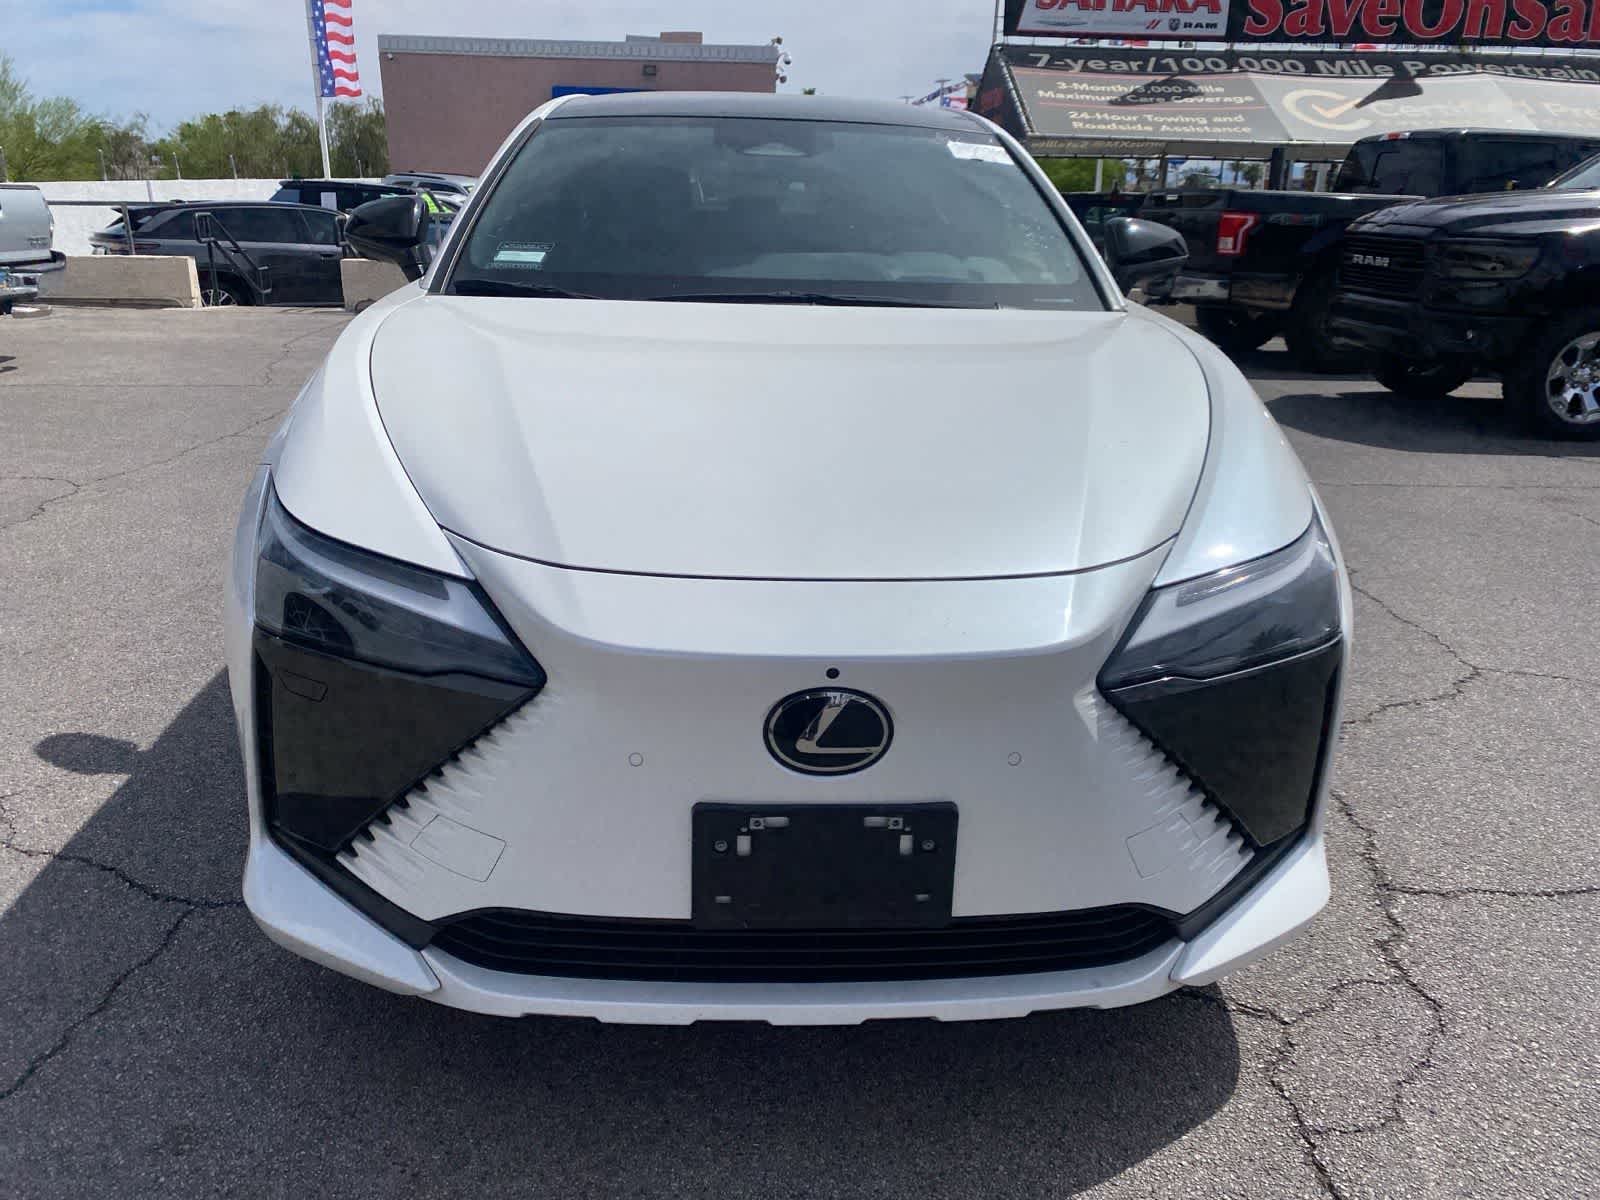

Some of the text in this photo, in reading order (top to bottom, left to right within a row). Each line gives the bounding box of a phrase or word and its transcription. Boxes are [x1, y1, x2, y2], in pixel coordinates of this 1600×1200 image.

[1183, 21, 1218, 30] RAM
[1315, 59, 1395, 76] Mile
[1402, 61, 1600, 81] Powertrain
[1037, 90, 1120, 102] Maximum
[1171, 95, 1255, 104] Coverage
[1068, 111, 1246, 125] 24-Hour Towing and
[1071, 121, 1252, 133] Roadside Assistance
[1352, 254, 1390, 267] RAM
